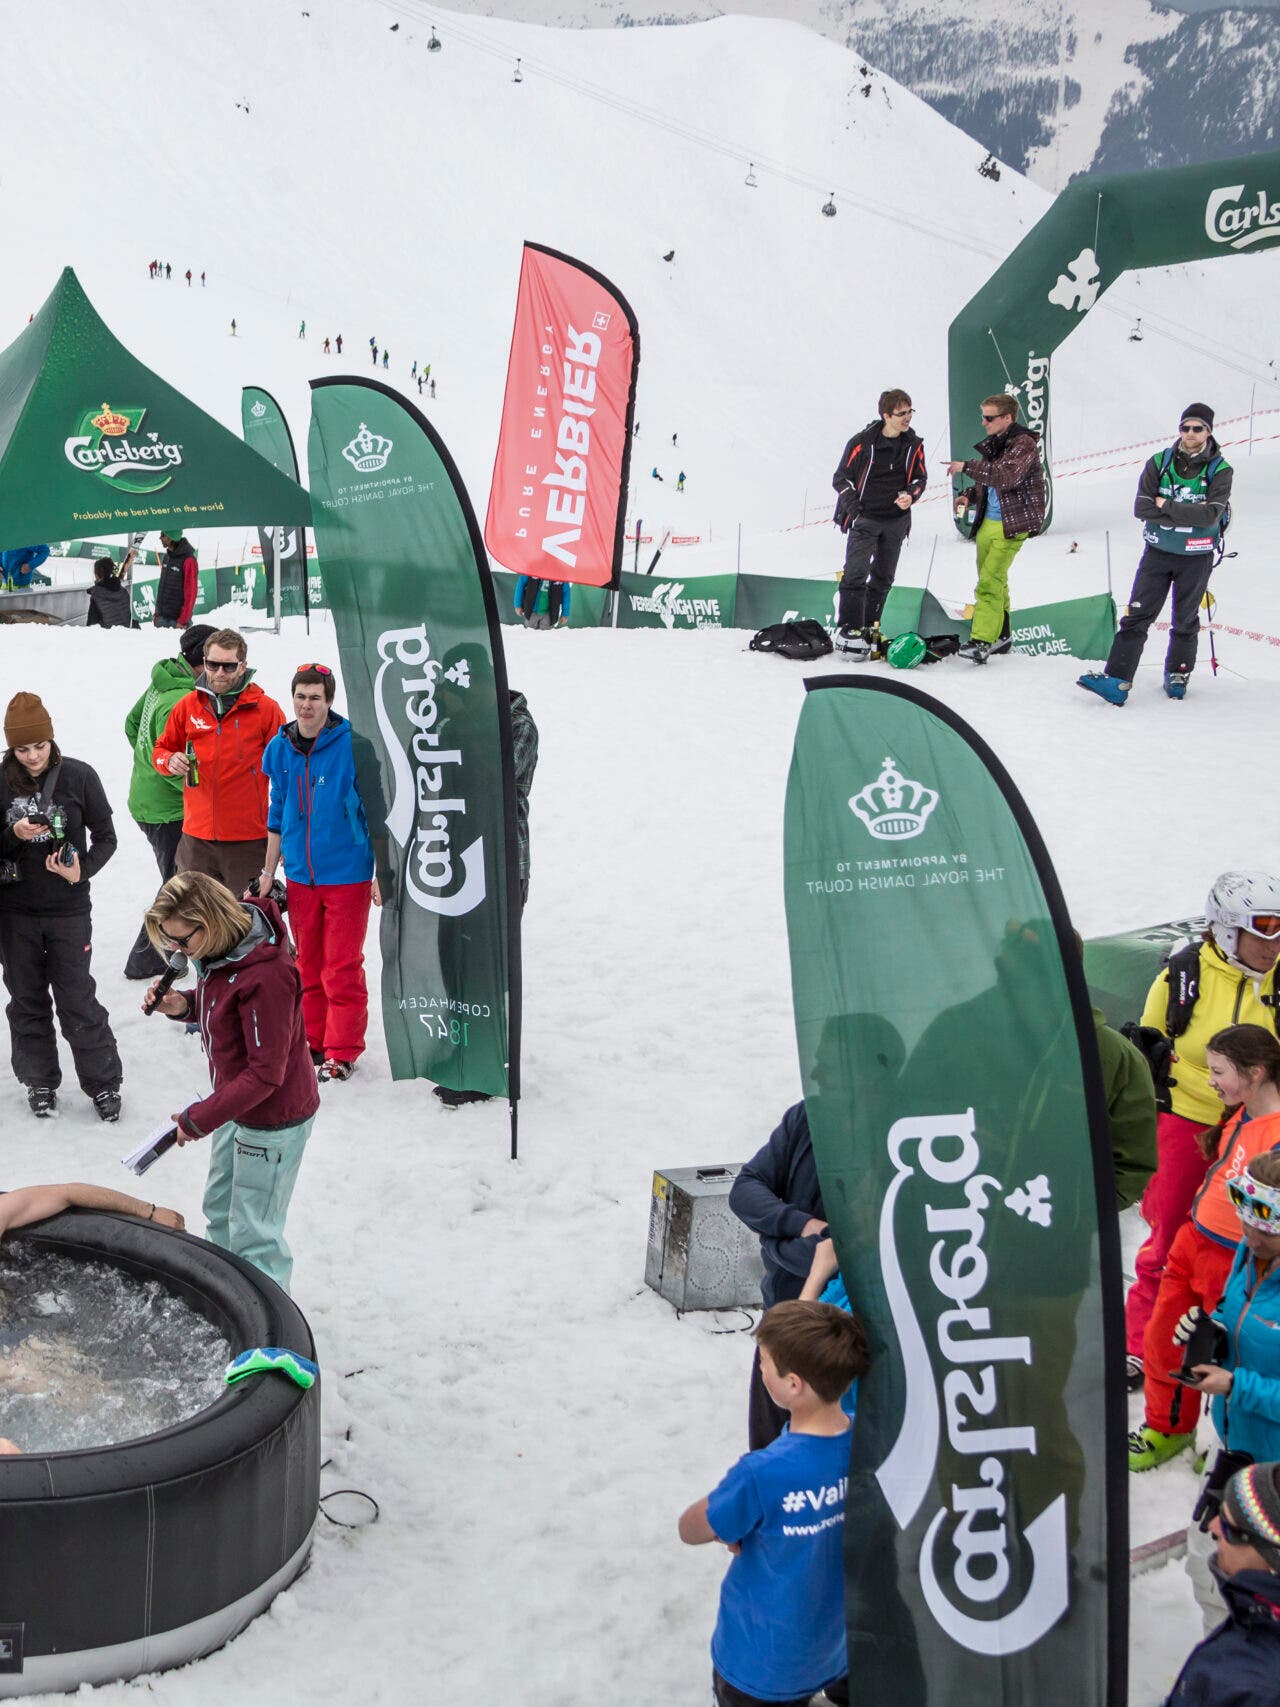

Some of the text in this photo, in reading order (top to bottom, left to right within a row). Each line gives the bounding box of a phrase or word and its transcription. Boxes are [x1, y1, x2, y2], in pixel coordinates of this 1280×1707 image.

[64, 434, 182, 478] Carlsberg
[73, 501, 224, 521] Probably the best beer in the world
[694, 599, 720, 616] FIVE
[1011, 624, 1055, 642] ASSION,
[1037, 639, 1072, 655] CARE.
